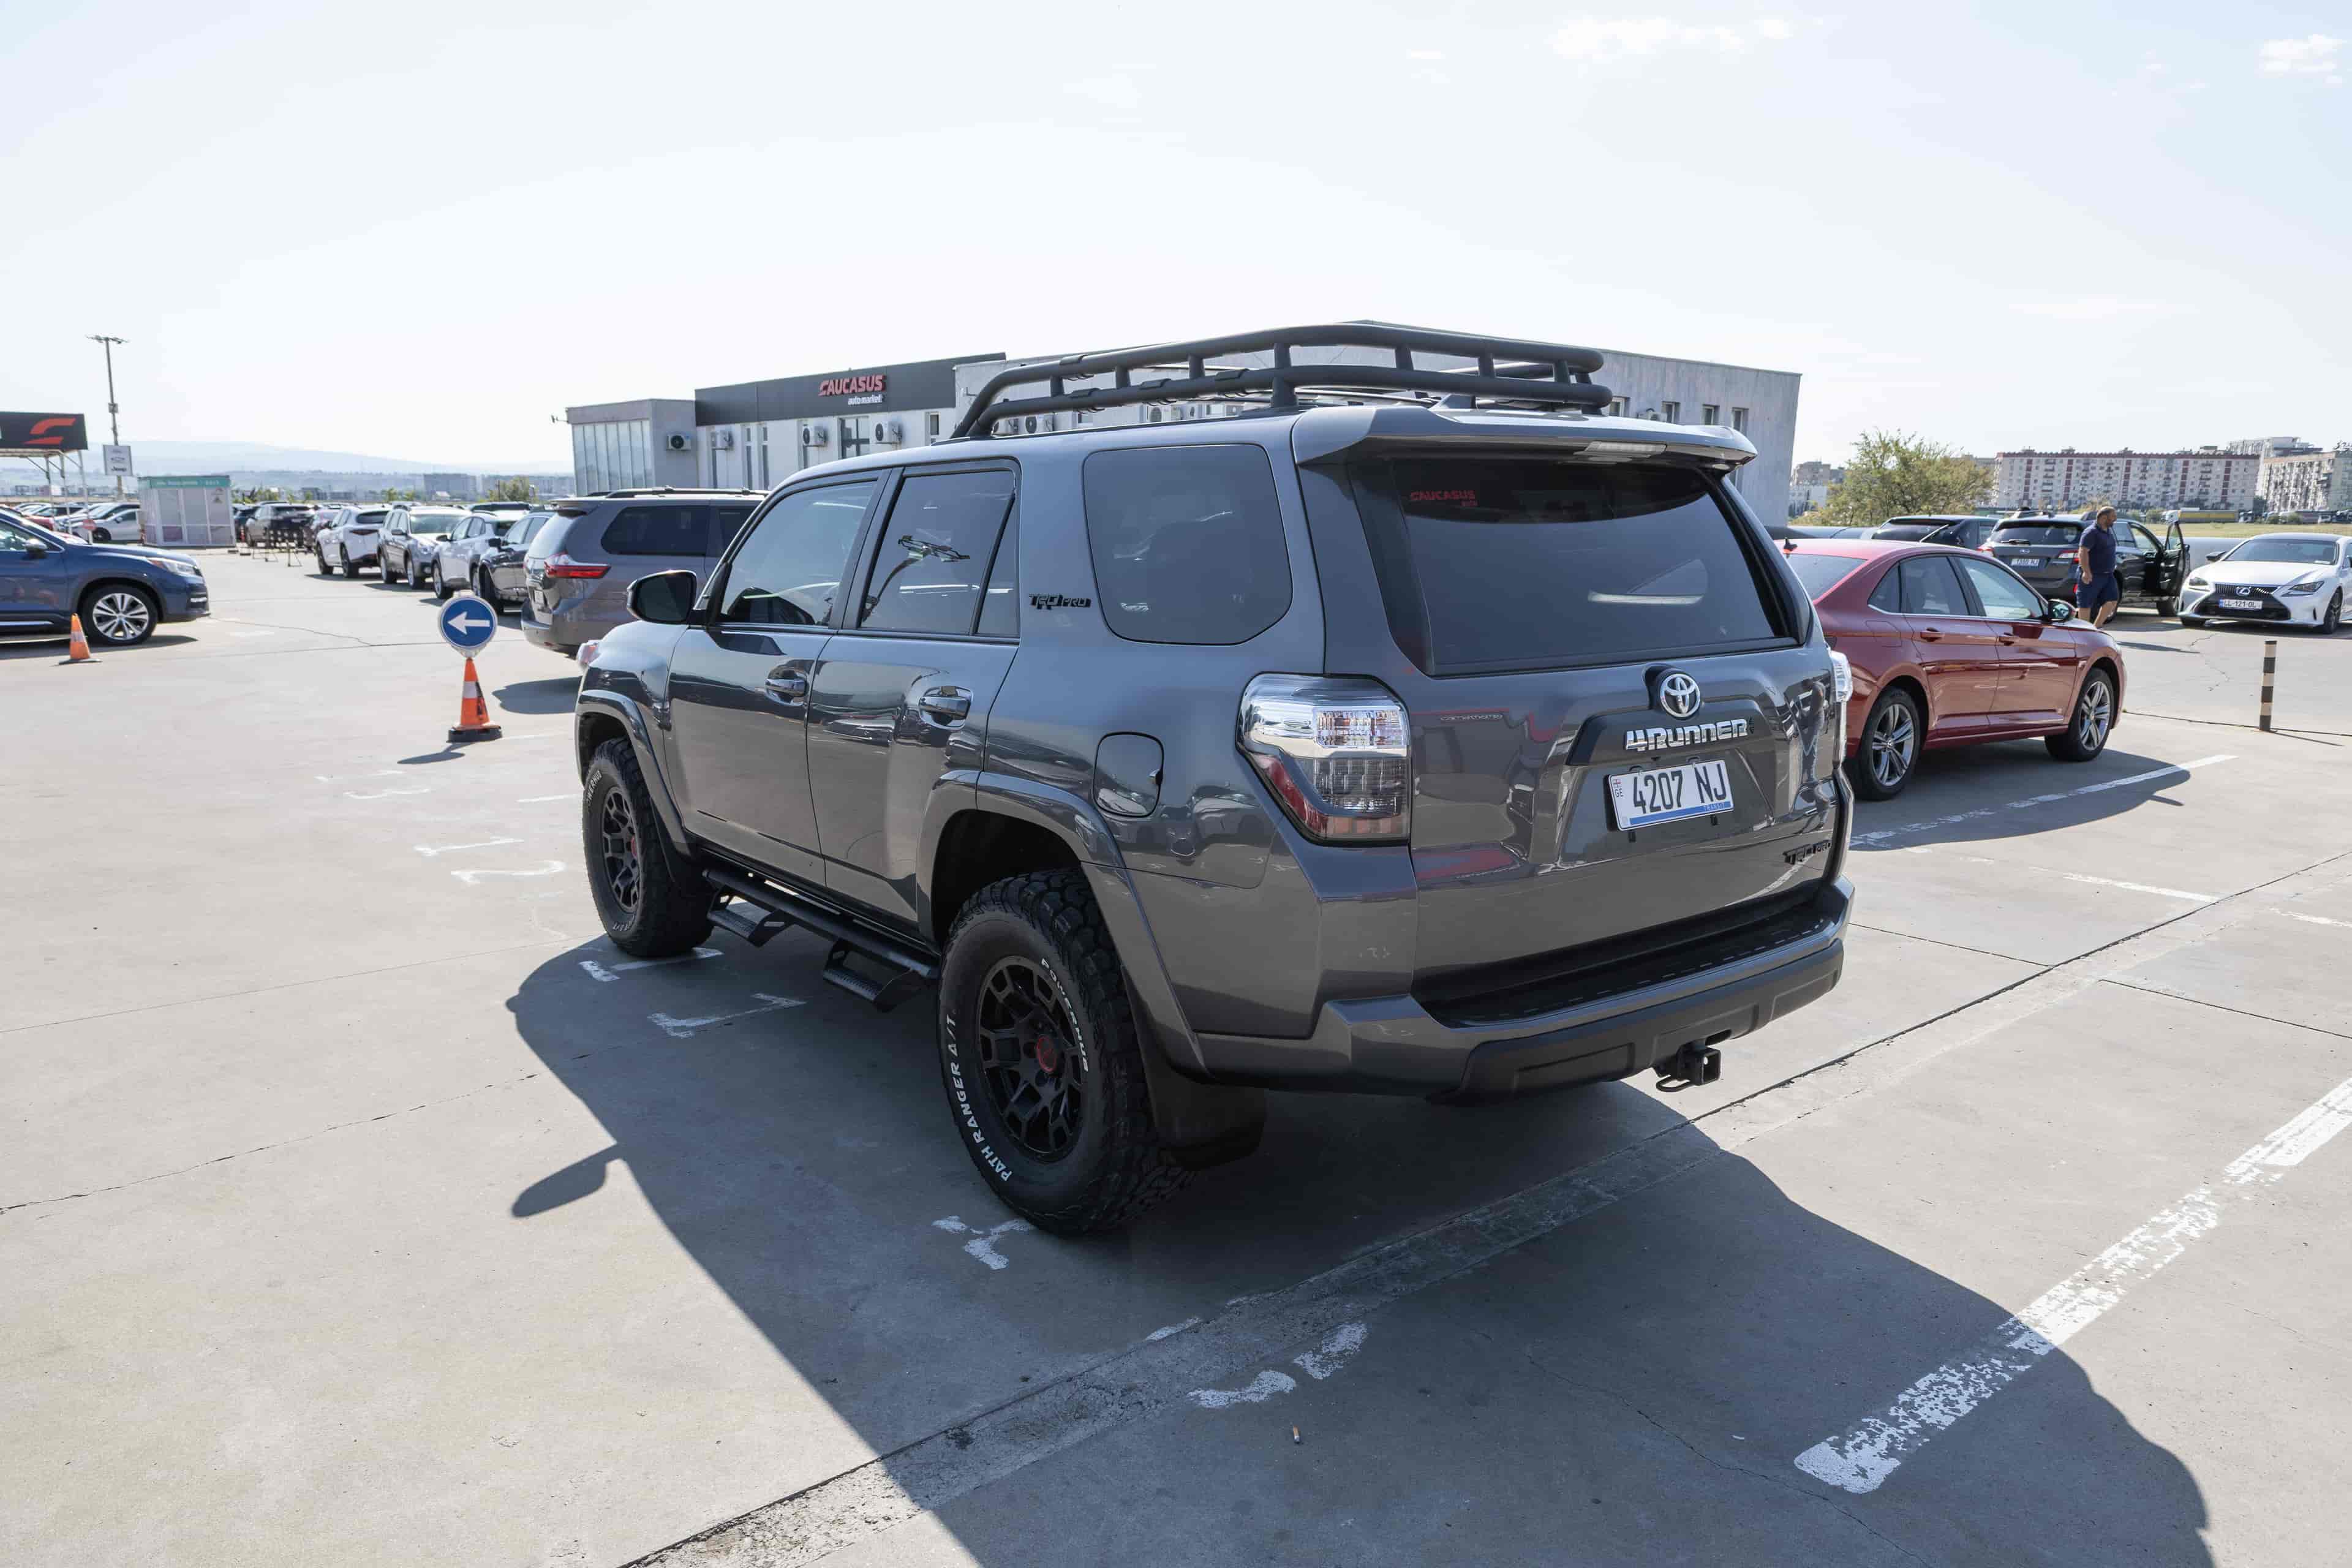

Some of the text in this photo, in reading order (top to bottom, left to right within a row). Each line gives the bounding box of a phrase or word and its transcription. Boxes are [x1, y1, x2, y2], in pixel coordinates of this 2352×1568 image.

[818, 374, 886, 396] CAUCASUS
[1625, 718, 1747, 752] 4RUNNER
[1633, 763, 1727, 815] 4207 NJ
[946, 1014, 1012, 1182] PATH RANGER A/T
